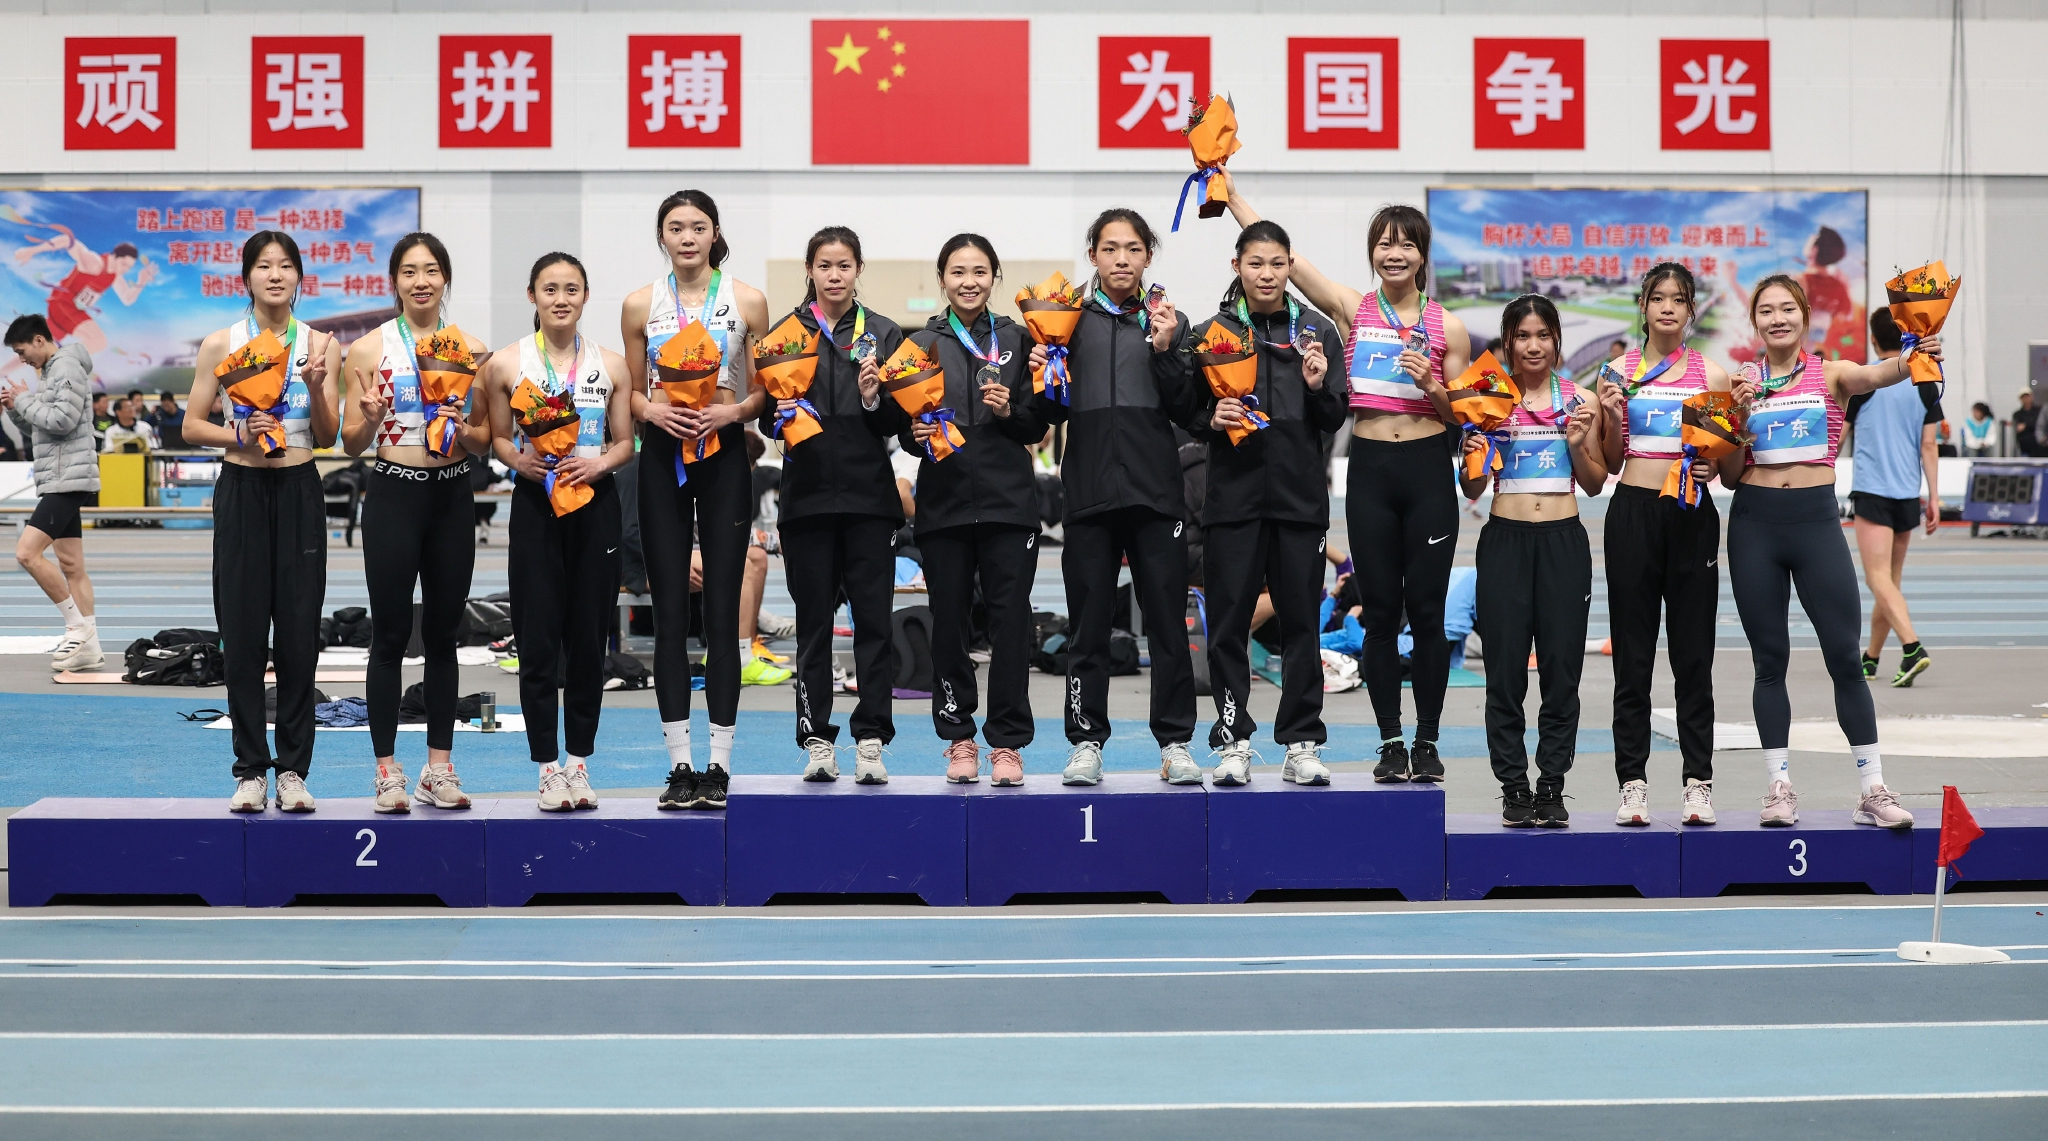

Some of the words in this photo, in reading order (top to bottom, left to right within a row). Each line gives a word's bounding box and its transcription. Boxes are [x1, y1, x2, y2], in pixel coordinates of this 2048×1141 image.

[76, 53, 162, 134] 顽
[265, 53, 349, 132] 强
[451, 50, 540, 133] 拼
[641, 50, 729, 133] 搏
[1115, 50, 1195, 133] 为
[1303, 52, 1383, 133] 国
[1486, 51, 1574, 136] 争
[1673, 54, 1757, 135] 光
[137, 208, 226, 232] 踏上跑道
[234, 208, 345, 232] 是一种选择
[1482, 224, 1572, 247] 胸怀大局
[1583, 224, 1671, 247] 自信开放
[1681, 224, 1769, 247] 迎难而上
[1532, 254, 1622, 277] 追求卓越
[1631, 255, 1718, 277] 共来
[302, 275, 395, 297] 是一种胜
[1646, 408, 1682, 428] 广东
[1767, 418, 1810, 441] 广东
[386, 465, 430, 481] PRO
[438, 460, 471, 481] NIKE
[1513, 449, 1557, 470] 广东
[1080, 804, 1098, 843] 1
[355, 828, 378, 867] 2
[1788, 838, 1808, 877] 3
